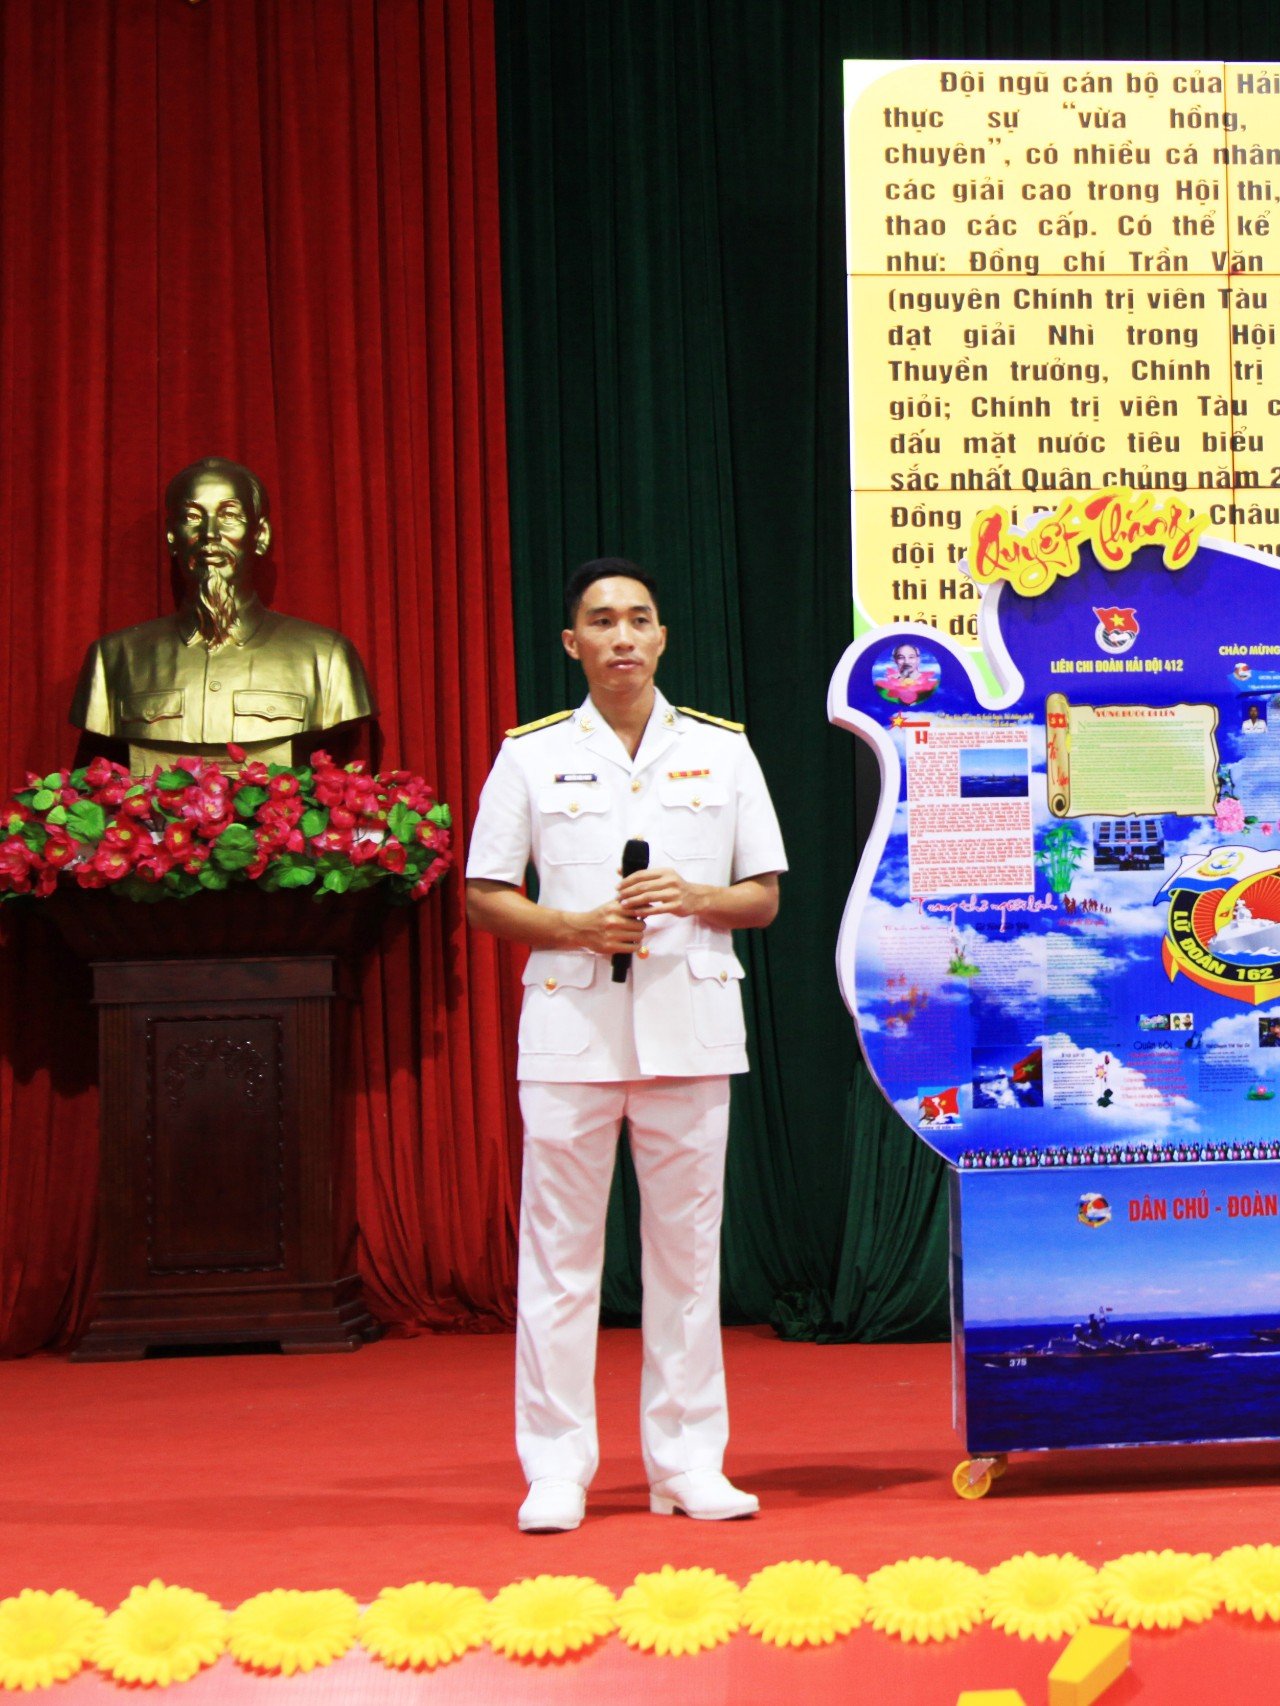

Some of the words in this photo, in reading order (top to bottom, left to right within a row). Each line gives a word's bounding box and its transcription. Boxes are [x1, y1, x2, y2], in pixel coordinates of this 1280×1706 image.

[941, 72, 984, 98] Đội
[1000, 74, 1048, 96] ngũ
[1064, 72, 1111, 93] cán
[1127, 73, 1158, 97] bộ
[1173, 72, 1221, 94] của
[1238, 71, 1280, 94] Hải
[884, 109, 943, 133] thực
[989, 110, 1019, 133] sự
[1170, 107, 1246, 133] hồng,
[1026, 143, 1057, 166] có
[1074, 143, 1150, 166] nhiều
[1166, 143, 1197, 166] cá
[1213, 144, 1280, 166] nhân
[886, 180, 935, 201] các
[953, 178, 1004, 204] giải
[1022, 183, 1071, 201] cao
[1088, 183, 1159, 204] trong
[1176, 181, 1220, 203] Hội
[1238, 182, 1280, 204] thi,
[886, 216, 946, 237] thao
[967, 215, 1016, 237] các
[1038, 212, 1097, 239] cấp.
[1118, 212, 1152, 237] Có
[1173, 212, 1215, 237] thể
[1237, 211, 1270, 237] kể
[887, 252, 946, 272] như:
[969, 248, 1039, 275] Đồng
[1064, 251, 1105, 272] chí
[1130, 248, 1187, 272] Trần
[1213, 252, 1262, 272] Văn
[889, 289, 1000, 312] (nguyên
[1014, 287, 1092, 311] Chính
[1106, 289, 1134, 314] trị
[1148, 288, 1205, 309] viên
[1219, 288, 1267, 310] Tàu
[888, 325, 931, 351] đạt
[964, 323, 1015, 348] giải
[1049, 323, 1094, 346] Nhì
[1127, 327, 1198, 348] trong
[1231, 323, 1275, 347] Hội
[889, 357, 988, 384] Thuyền
[1010, 358, 1108, 384] trưởng,
[1132, 359, 1210, 381] Chính
[1233, 361, 1263, 385] trị
[890, 394, 951, 421] giỏi;
[972, 395, 1050, 418] Chính
[1071, 397, 1099, 422] trị
[1120, 396, 1177, 417] viên
[1200, 395, 1247, 417] Tàu
[964, 432, 1016, 458] mặt
[1038, 431, 1105, 453] nước
[1128, 432, 1179, 453] tiêu
[1203, 426, 1263, 453] biểu
[891, 465, 938, 490] sắc
[951, 464, 1012, 490] nhất
[1022, 468, 1090, 490] Quân
[1103, 467, 1187, 491] chủng
[1199, 467, 1258, 489] năm
[891, 503, 961, 529] Đồng
[892, 544, 934, 568] đội
[975, 504, 1080, 589] Quyết
[893, 580, 927, 601] thi
[940, 578, 982, 601] Hả
[949, 614, 978, 641] độ
[1219, 643, 1247, 656] CHÀO
[1249, 644, 1280, 656] MỪNG
[1051, 658, 1074, 673] LIÊN
[1076, 660, 1094, 673] CHI
[1126, 656, 1143, 672] HẢI
[1164, 659, 1184, 672] 412
[1174, 911, 1191, 932] LỮ
[1180, 938, 1226, 974] ĐOÀN
[1236, 968, 1274, 980] 162
[1129, 1194, 1166, 1222] DÂN
[1172, 1189, 1209, 1220] CHỦ
[1227, 1190, 1278, 1218] ĐOÀN
